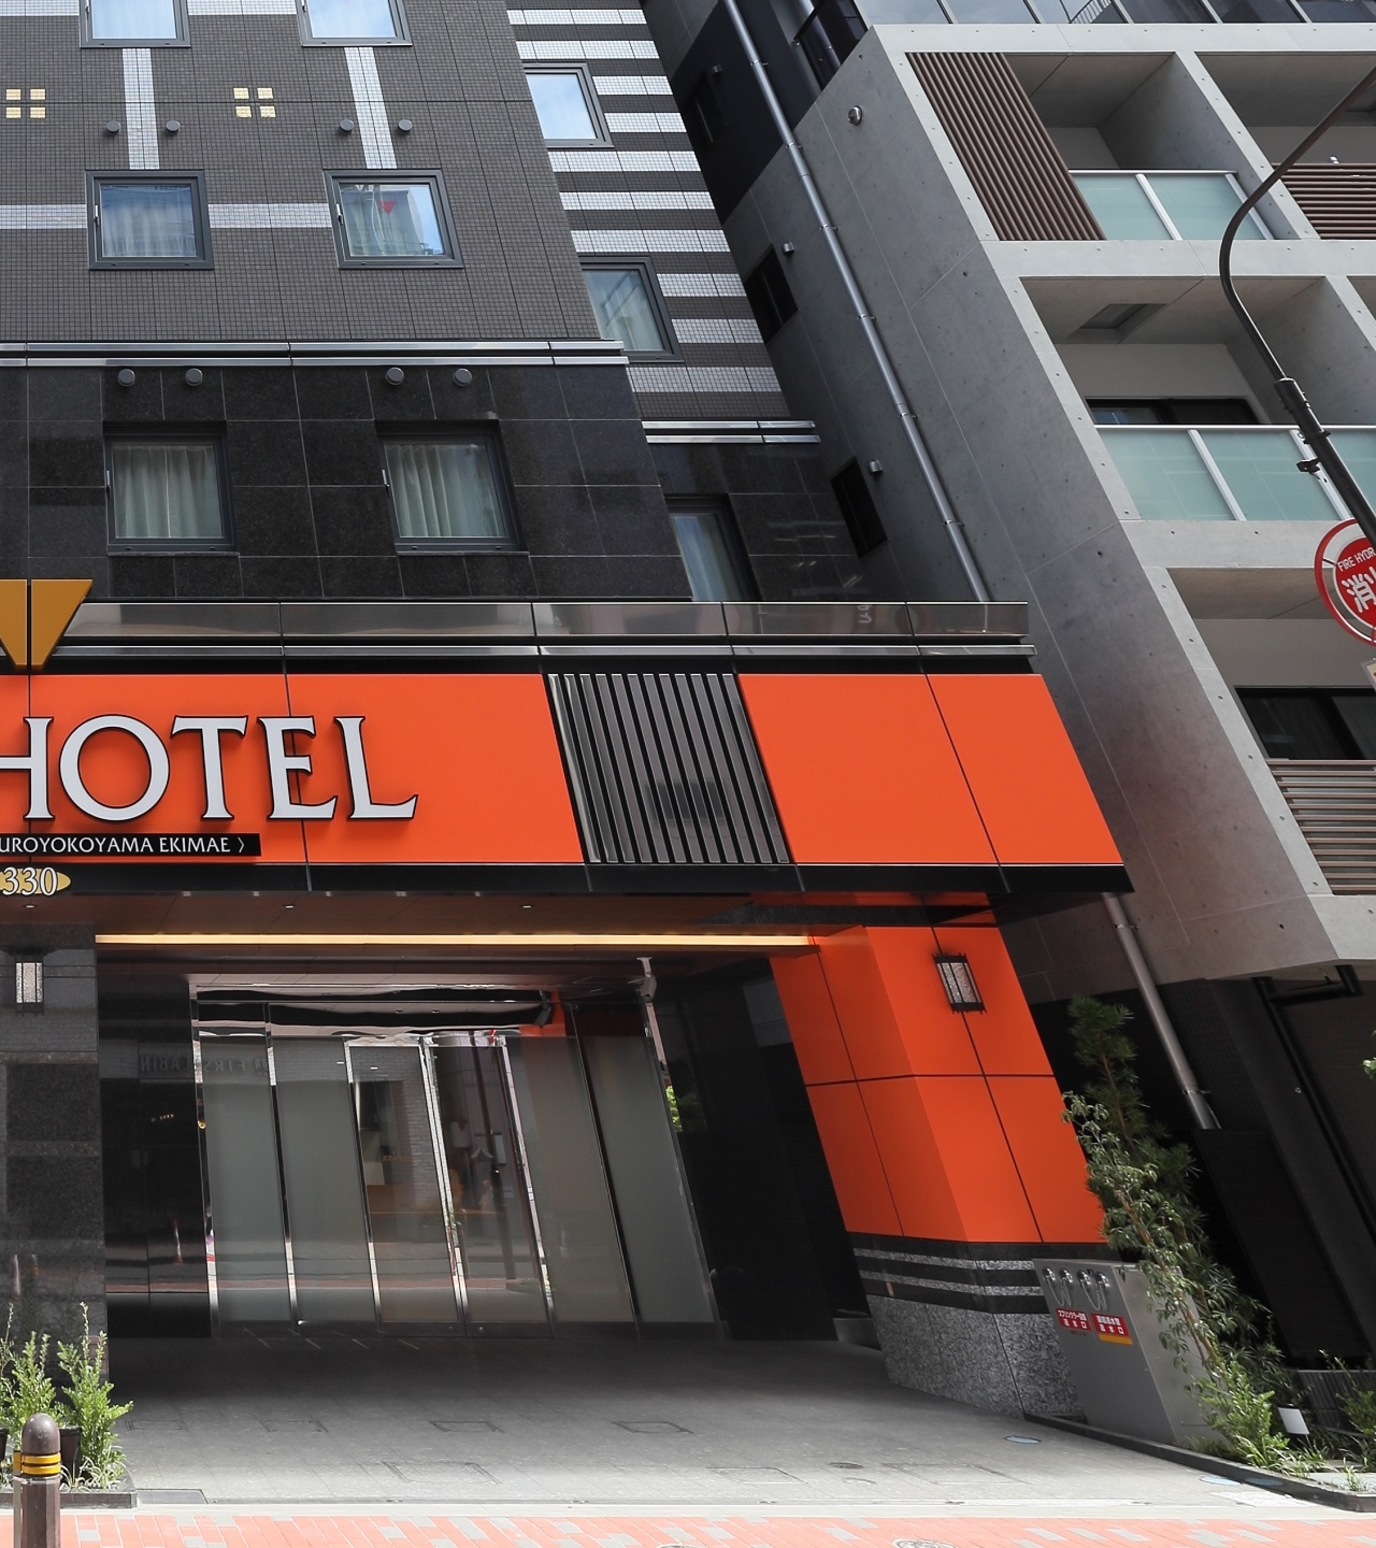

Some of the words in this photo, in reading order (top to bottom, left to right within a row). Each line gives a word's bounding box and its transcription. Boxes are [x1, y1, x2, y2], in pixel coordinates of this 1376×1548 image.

[1337, 556, 1356, 571] FIRE
[159, 836, 231, 853] EKIMAE
[1, 866, 59, 897] 330
